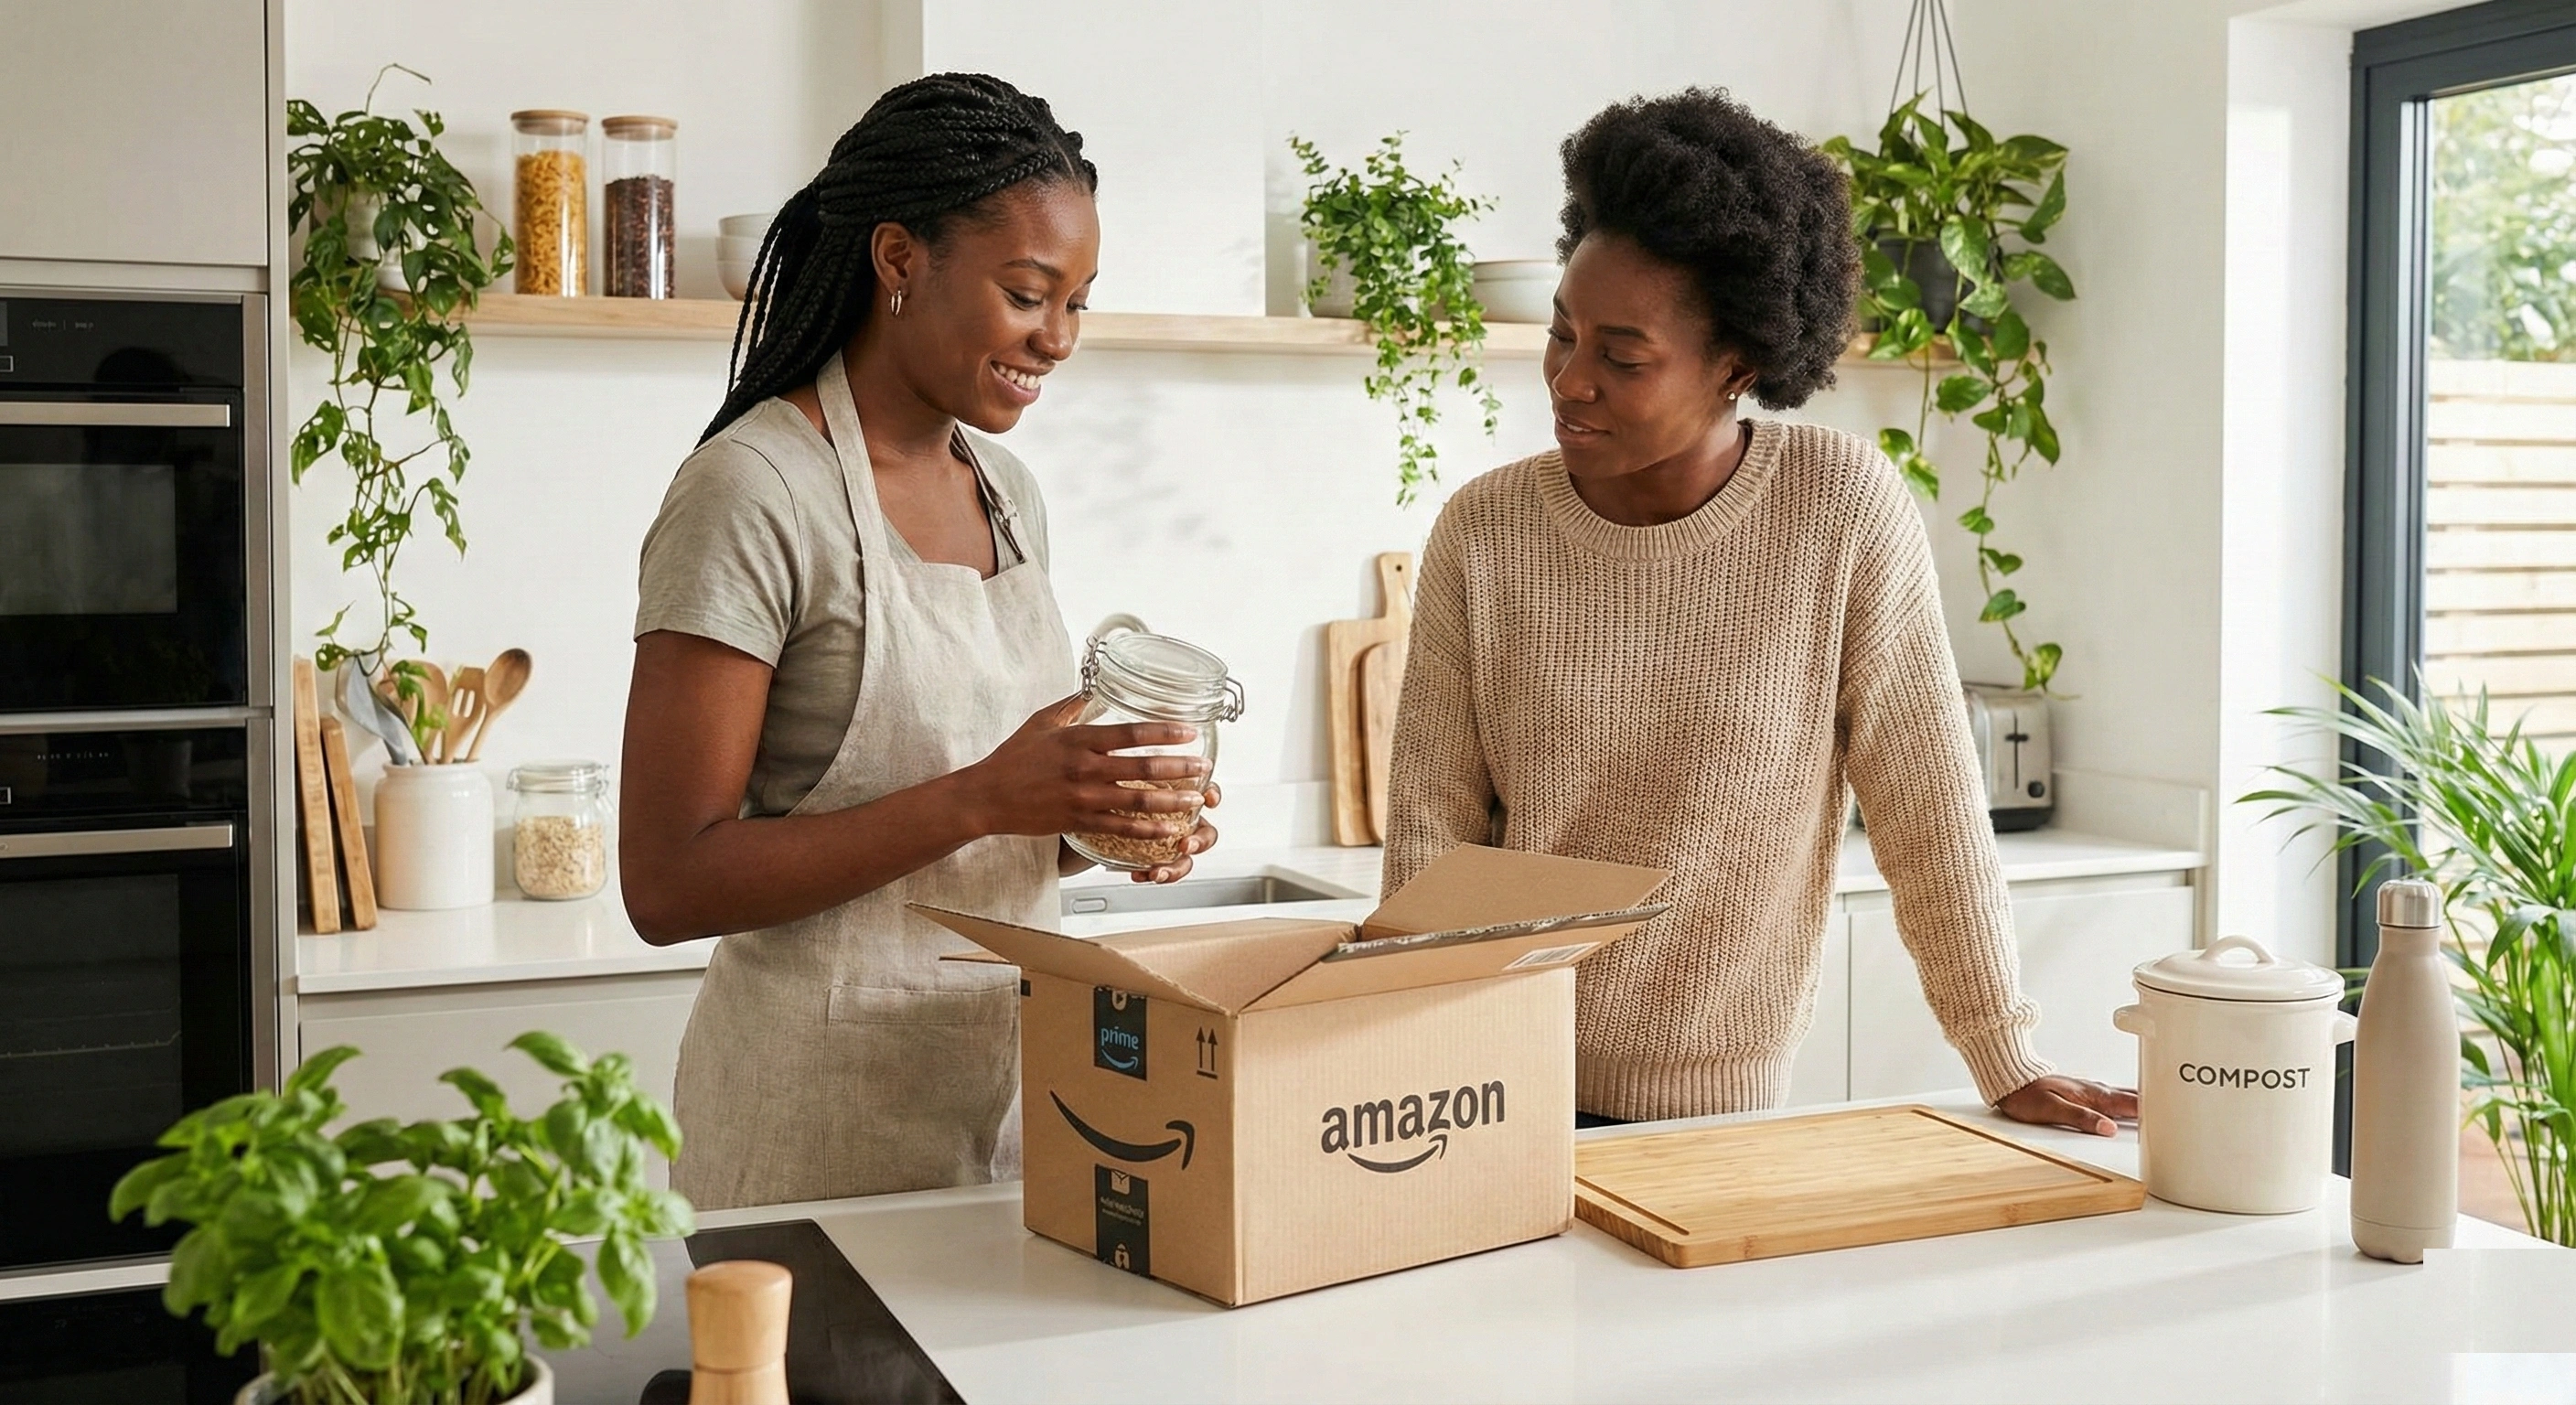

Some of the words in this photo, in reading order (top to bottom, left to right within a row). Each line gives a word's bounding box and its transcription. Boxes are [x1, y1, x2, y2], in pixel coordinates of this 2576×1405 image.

[1100, 1026, 1140, 1050] prime
[2179, 1063, 2311, 1089] COMPOST
[1321, 1080, 1505, 1153] amazon
